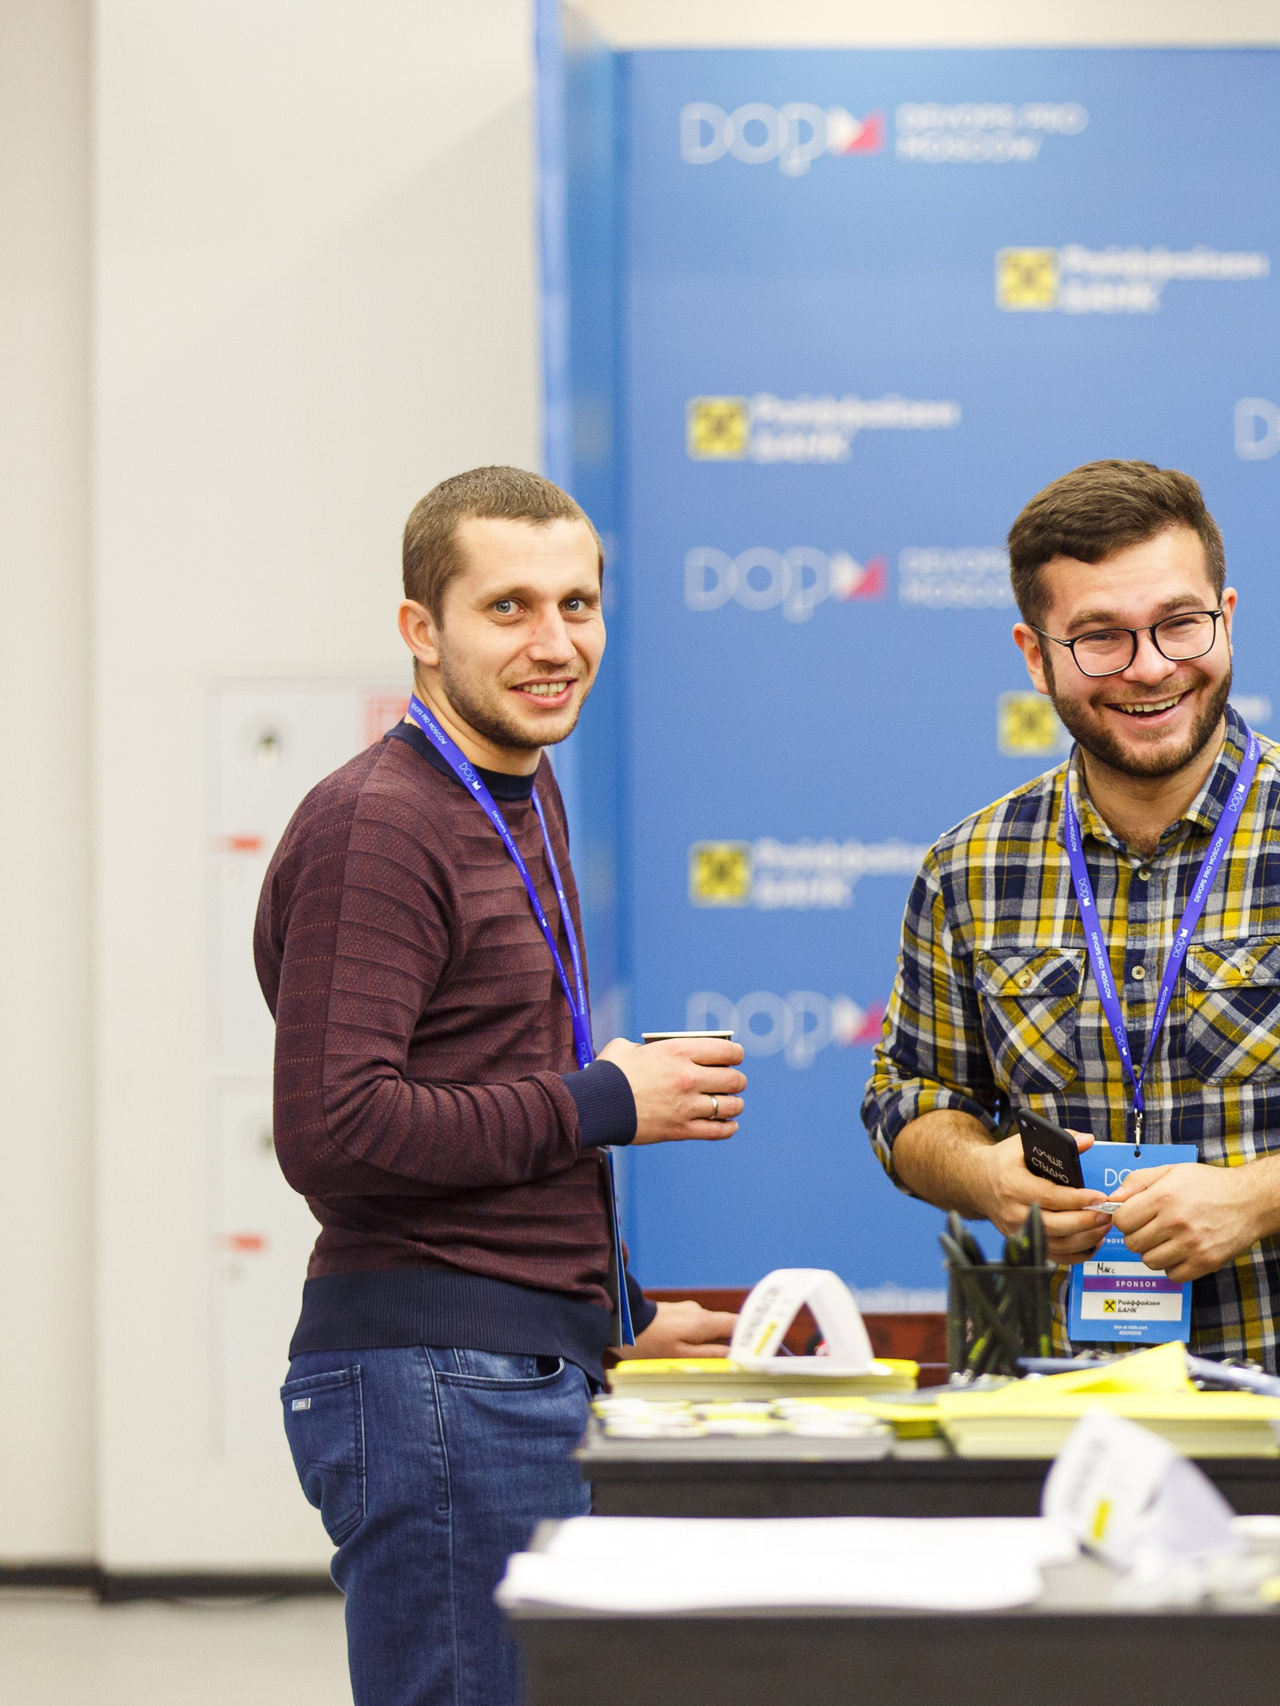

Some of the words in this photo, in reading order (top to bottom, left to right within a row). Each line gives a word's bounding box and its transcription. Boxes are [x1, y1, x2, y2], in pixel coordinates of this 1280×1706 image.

[429, 722, 448, 746] MOSCOW
[1194, 878, 1208, 903] DEVOPS
[1203, 864, 1213, 879] PRO
[1209, 836, 1225, 866] MOSCOW
[1091, 931, 1102, 957] DEVOPS
[1096, 955, 1105, 970] PRO
[1099, 969, 1113, 999] MOSCOW
[1032, 1146, 1064, 1170] ЛУЧШЕ
[1031, 1157, 1069, 1184] СТЫДНО
[1104, 1168, 1138, 1187] DO
[1115, 1280, 1157, 1288] SPONSOR
[1117, 1299, 1161, 1307] Райффайзен
